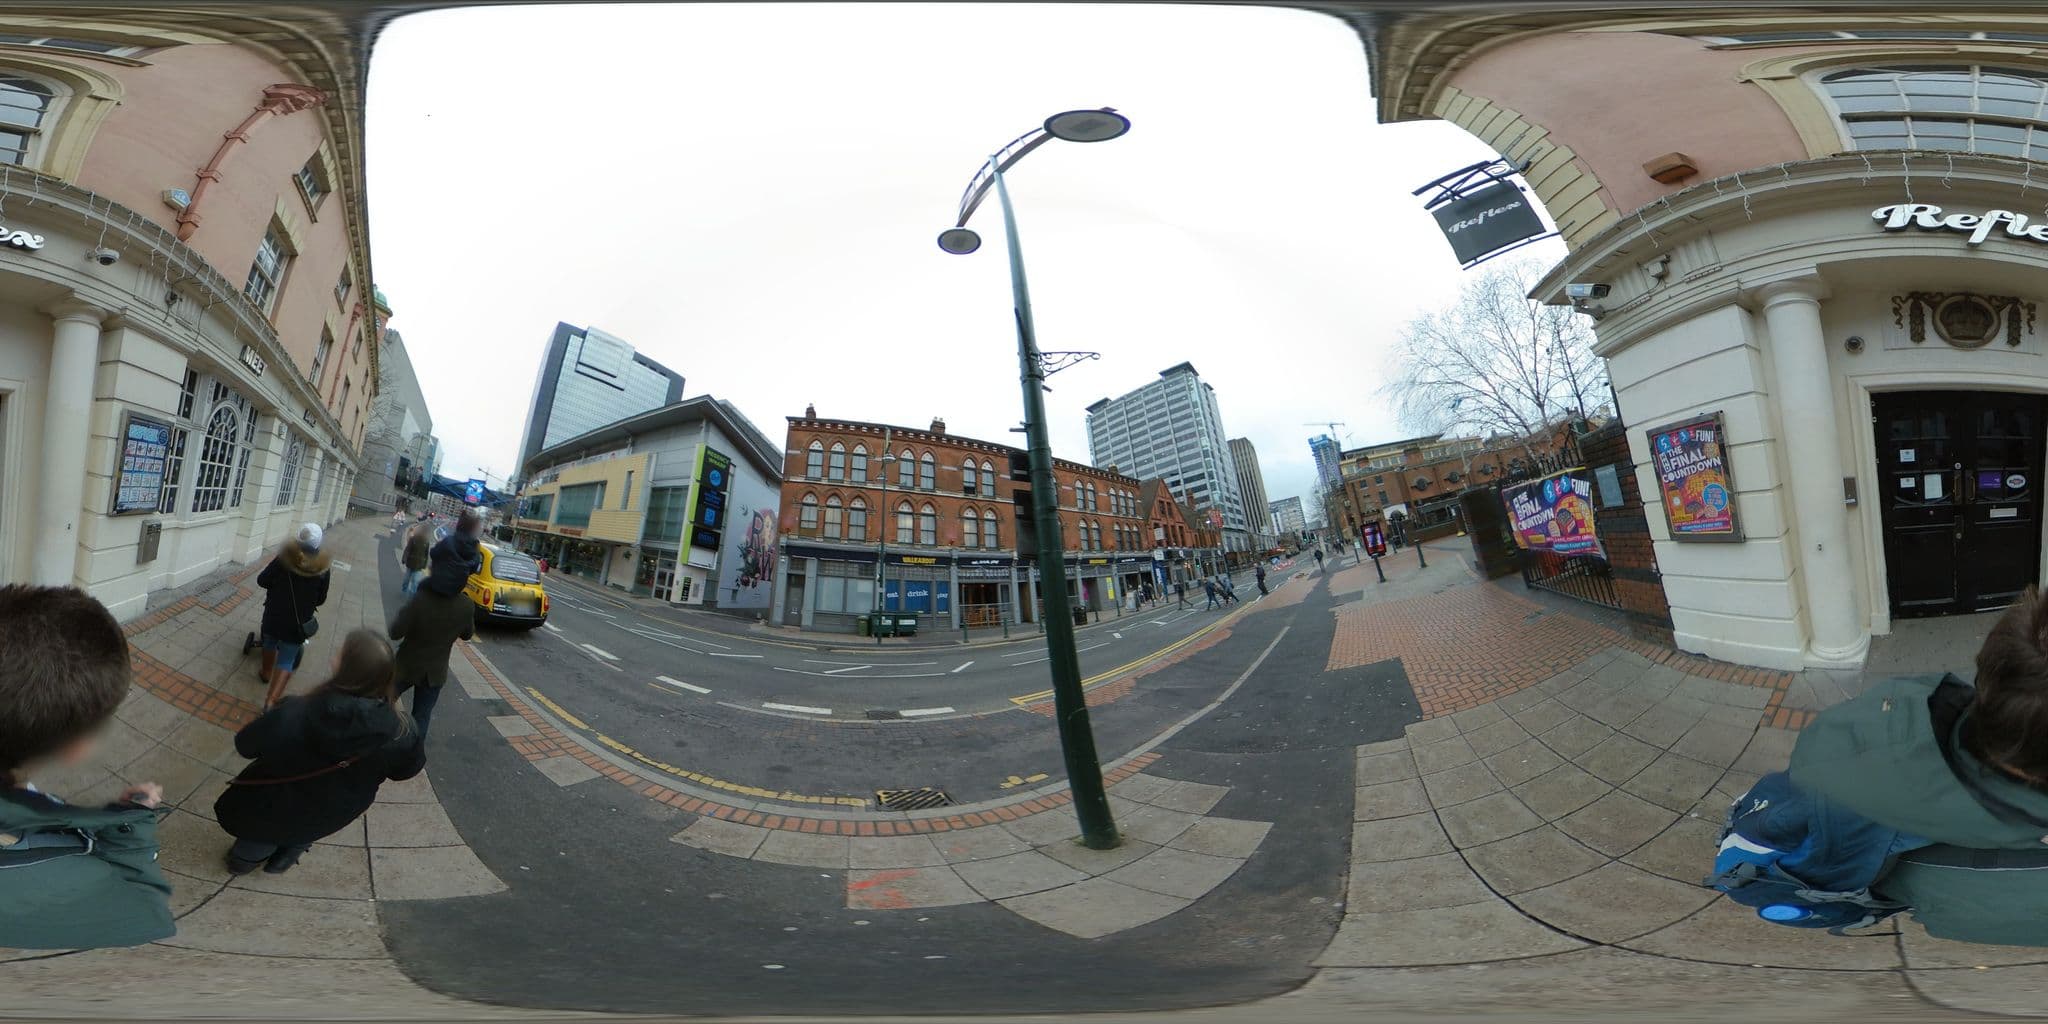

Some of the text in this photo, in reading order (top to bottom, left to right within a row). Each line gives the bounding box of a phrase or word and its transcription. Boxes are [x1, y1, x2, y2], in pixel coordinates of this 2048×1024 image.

[1667, 445, 1683, 458] THE
[1669, 448, 1706, 470] FINAL
[1662, 456, 1722, 483] COUNTDOWN
